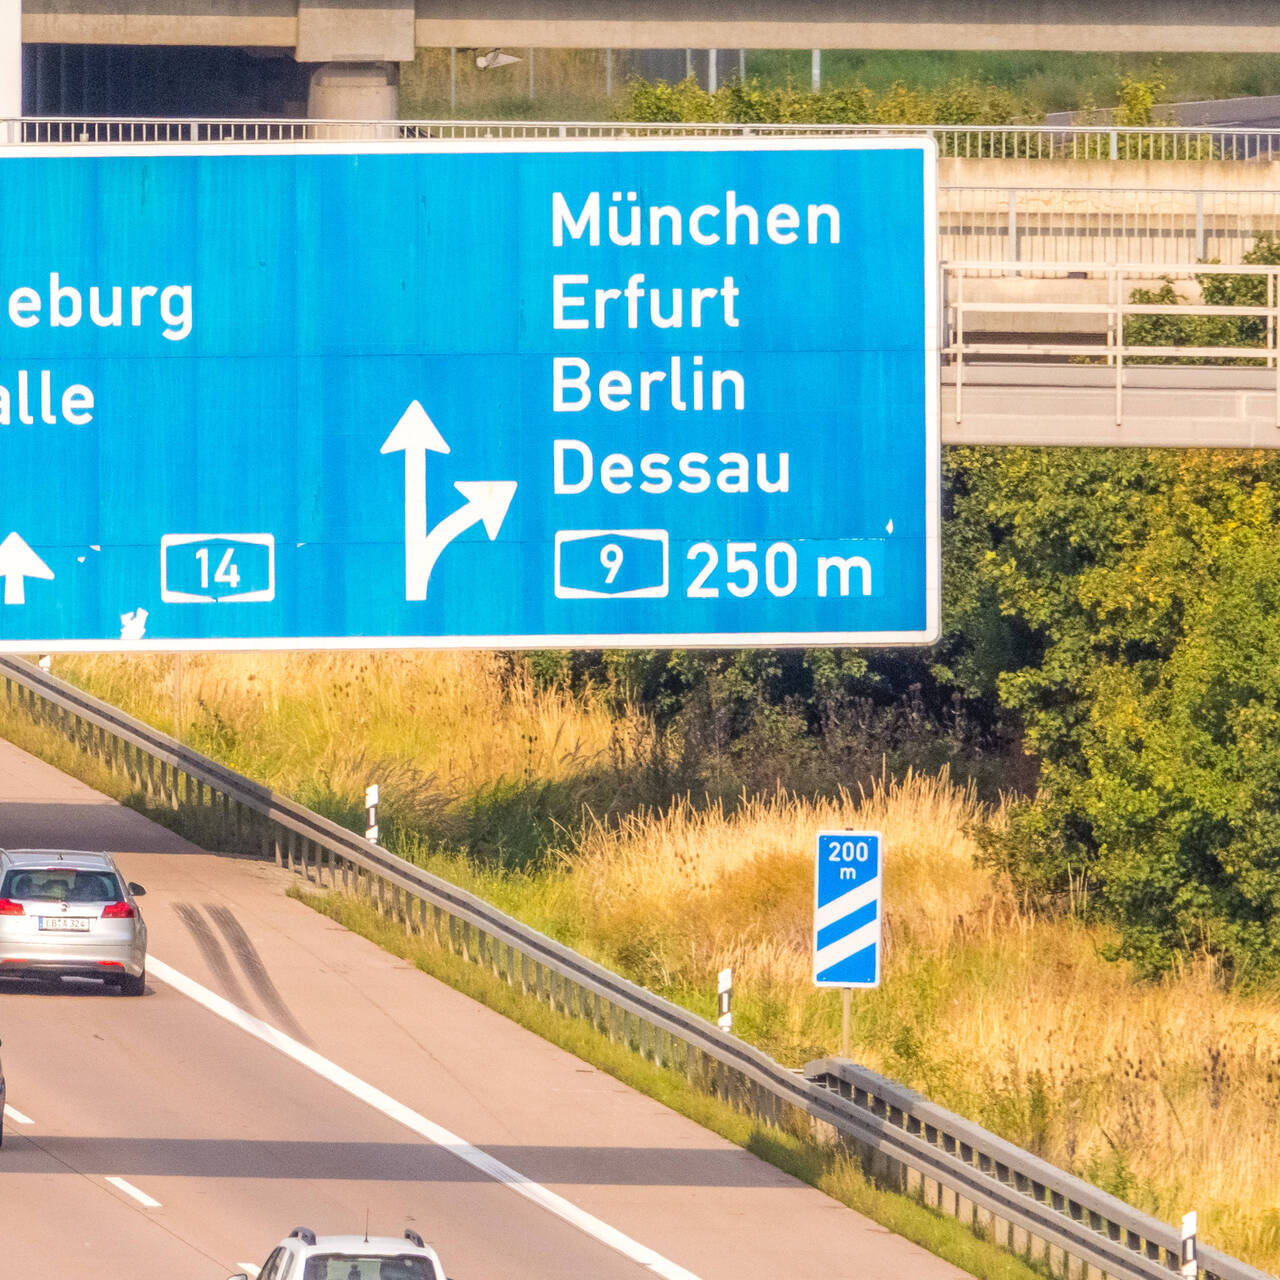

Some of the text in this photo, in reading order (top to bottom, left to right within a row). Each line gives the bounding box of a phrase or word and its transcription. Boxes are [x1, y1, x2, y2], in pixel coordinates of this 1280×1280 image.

[552, 189, 841, 248] München
[552, 273, 740, 330] Erfurt
[552, 355, 745, 413] Berlin
[553, 438, 790, 495] Dessau
[195, 547, 241, 589] 14
[599, 543, 624, 584] 9
[686, 541, 872, 599] 250 m
[828, 841, 869, 862] 200
[839, 867, 857, 880] m
